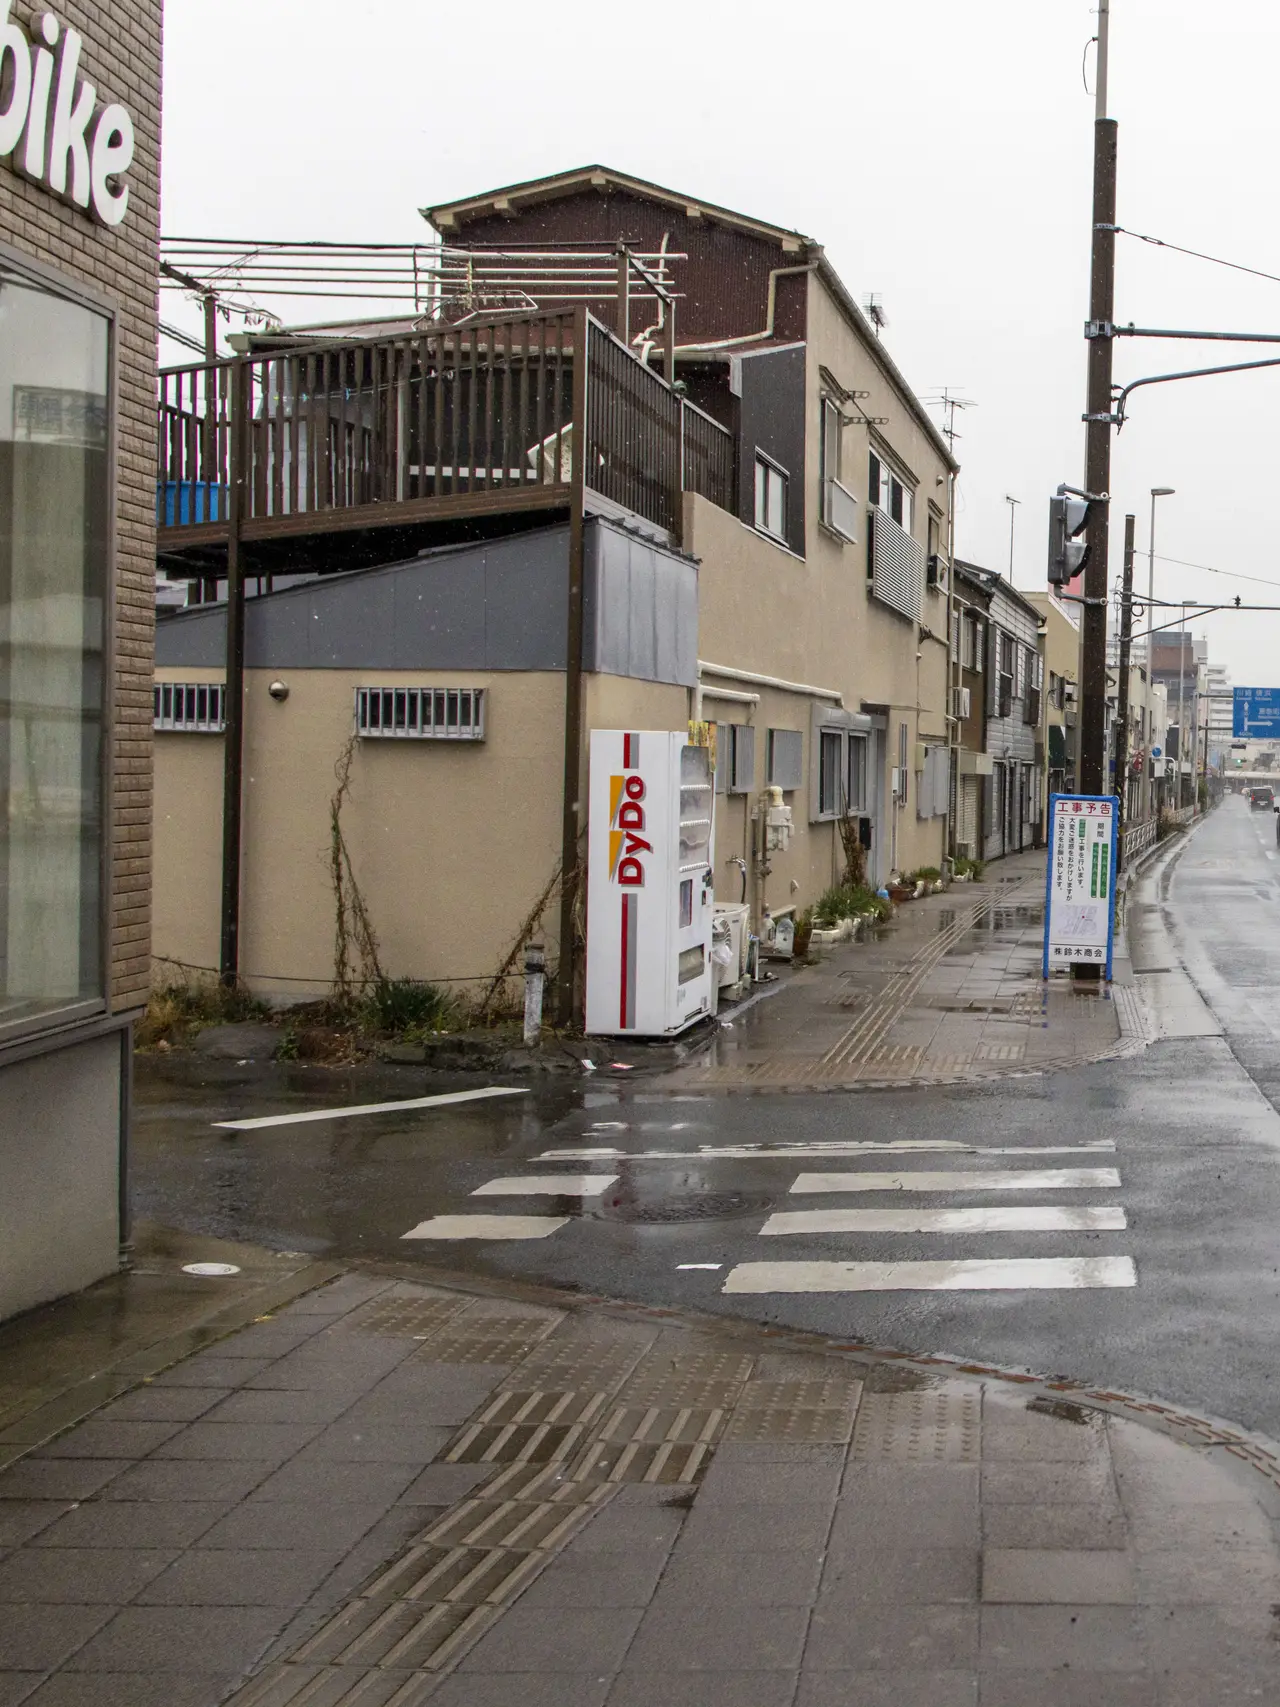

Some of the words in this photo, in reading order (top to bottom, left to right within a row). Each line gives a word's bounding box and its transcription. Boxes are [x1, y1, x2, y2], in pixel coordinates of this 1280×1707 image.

[618, 775, 651, 885] DyDo
[1057, 802, 1111, 815] 工事予告
